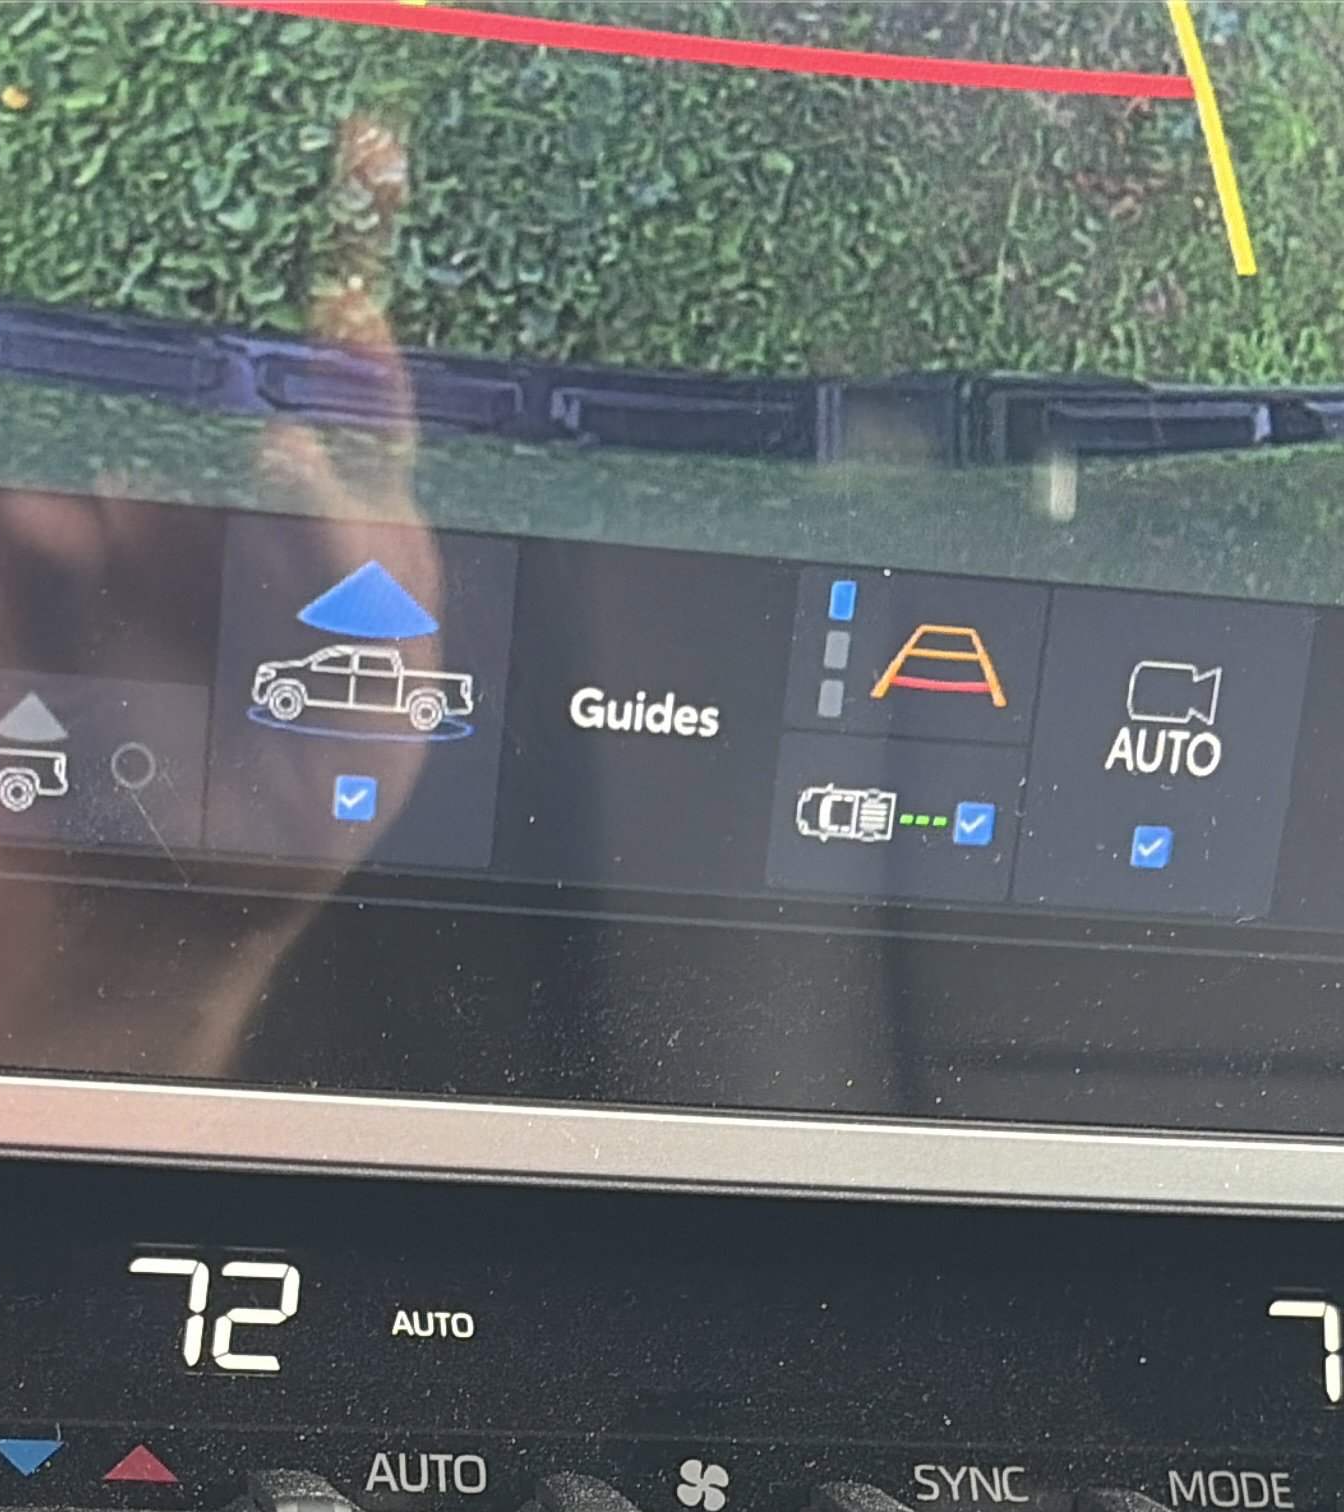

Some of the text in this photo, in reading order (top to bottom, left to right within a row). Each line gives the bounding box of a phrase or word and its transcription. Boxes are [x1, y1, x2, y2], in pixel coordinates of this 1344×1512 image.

[570, 687, 720, 737] Guides
[1104, 726, 1222, 777] AUTO
[129, 1257, 300, 1371] 72
[391, 1310, 474, 1338] AUTO
[365, 1452, 487, 1494] AUTO
[914, 1464, 1030, 1503] SYNC
[1168, 1470, 1295, 1509] MODE
